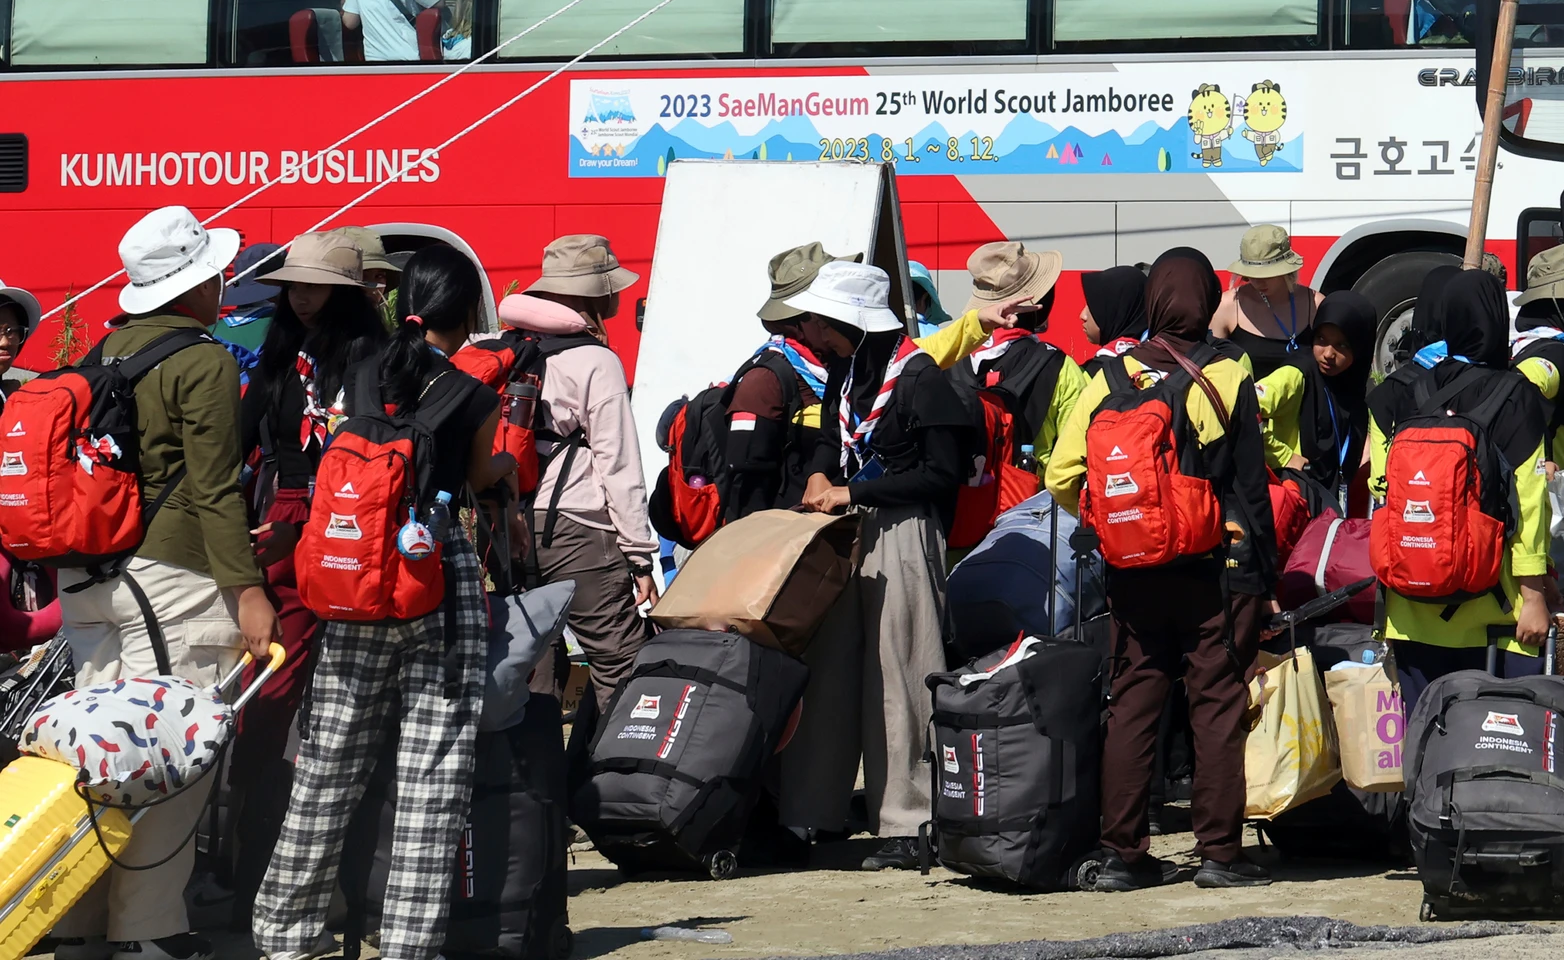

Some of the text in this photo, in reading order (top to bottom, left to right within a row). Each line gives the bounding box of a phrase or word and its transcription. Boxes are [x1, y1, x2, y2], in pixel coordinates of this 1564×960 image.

[660, 87, 1174, 118] 2023 SaeManGeum 25th World Scout Jamboree
[904, 137, 921, 162] 1.
[946, 136, 965, 162] 8.
[970, 136, 1000, 162] 12.
[60, 148, 441, 186] KUMHOTOUR BUSLINES
[579, 157, 638, 169] Draw your Dream!
[1108, 508, 1140, 519] INDONESIA
[1400, 541, 1437, 549] CONTINGENT
[1402, 535, 1433, 543] INDONESIA
[323, 554, 359, 564] INDONESIA
[320, 560, 362, 571] CONTINGENT
[655, 684, 697, 759] EIGER
[623, 725, 657, 733] INDONESIA
[617, 732, 657, 740] CONTINGENT
[1479, 736, 1529, 748] INDONESIA
[1474, 742, 1534, 754] CONTINGENT
[971, 732, 985, 817] EIGER
[460, 823, 475, 898] EIGE
